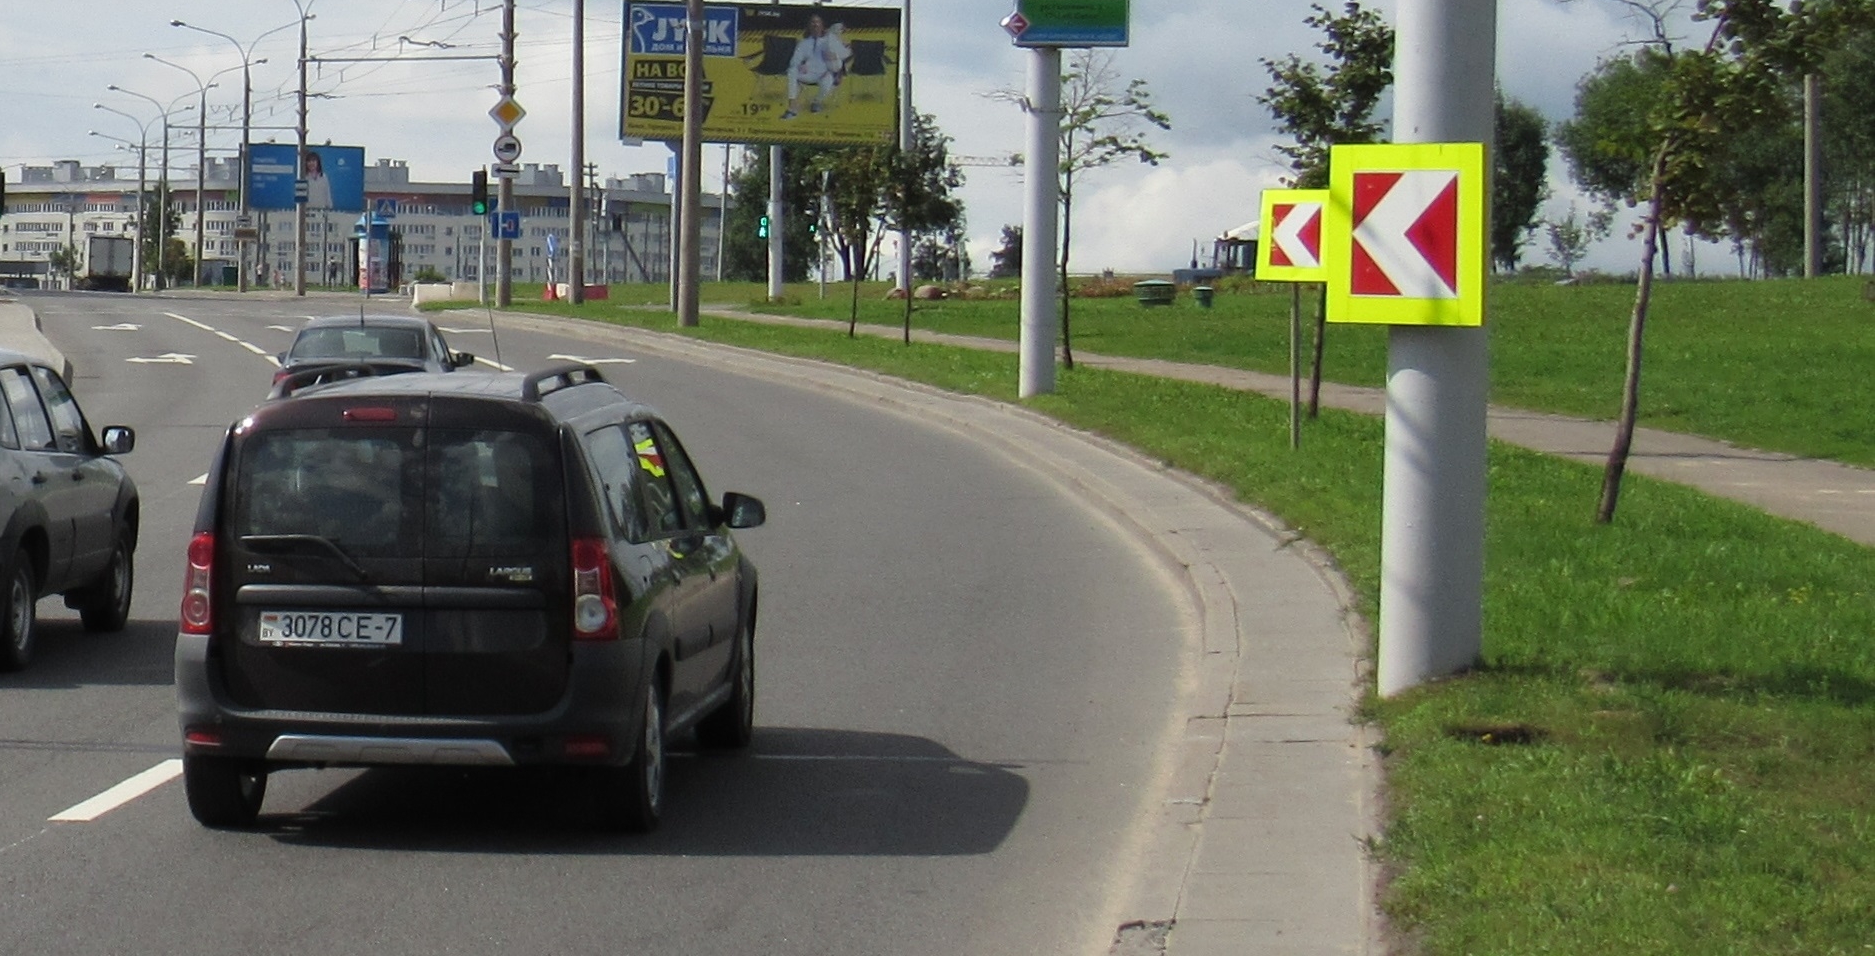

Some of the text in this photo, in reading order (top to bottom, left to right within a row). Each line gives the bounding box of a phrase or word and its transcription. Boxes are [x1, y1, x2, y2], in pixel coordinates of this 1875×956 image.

[651, 17, 732, 43] JYK
[651, 42, 675, 52] ДОМ
[636, 62, 662, 78] НА
[281, 615, 333, 638] 3078
[337, 615, 398, 641] CE-7
